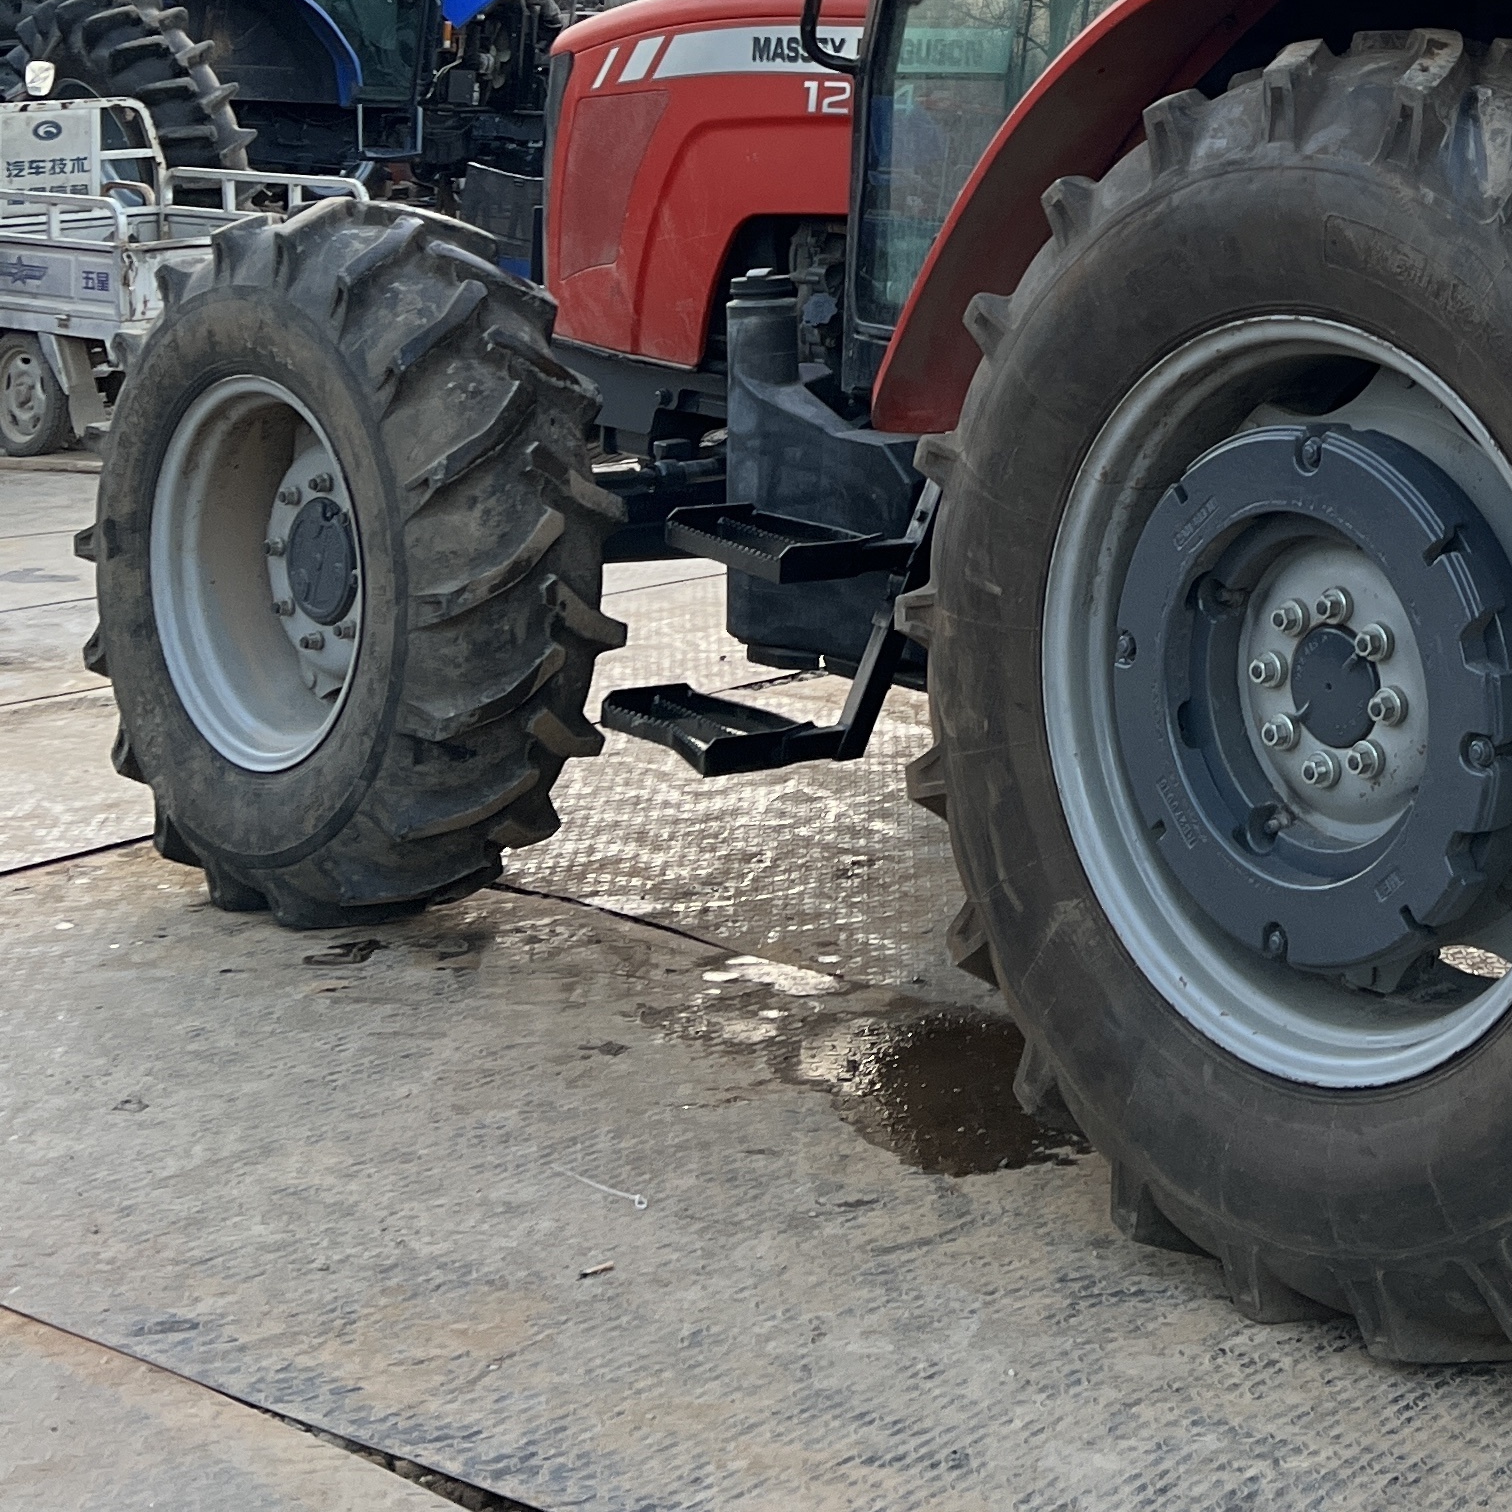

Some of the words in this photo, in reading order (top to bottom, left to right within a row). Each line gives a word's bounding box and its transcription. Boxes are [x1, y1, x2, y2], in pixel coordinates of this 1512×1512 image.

[6, 156, 91, 178] 汽车技术
[82, 270, 109, 291] 五星
